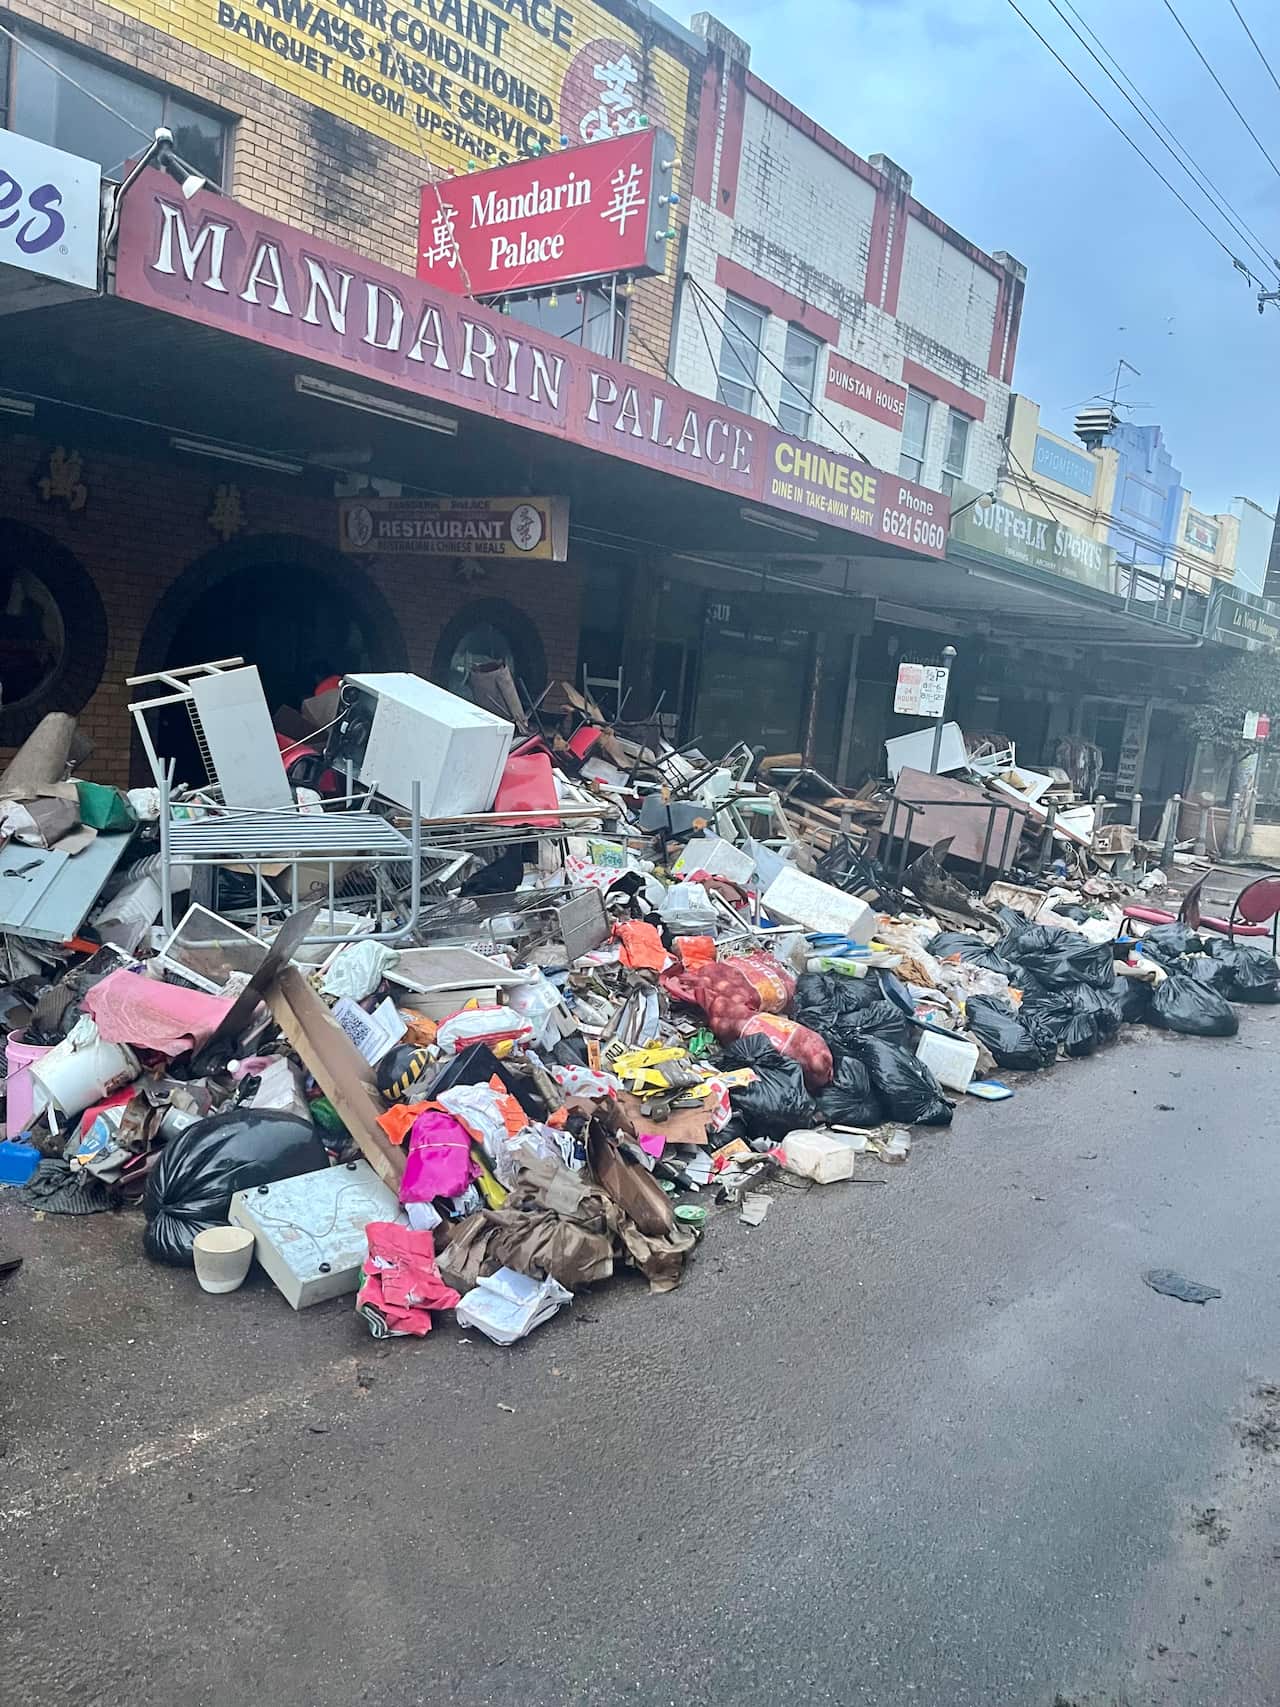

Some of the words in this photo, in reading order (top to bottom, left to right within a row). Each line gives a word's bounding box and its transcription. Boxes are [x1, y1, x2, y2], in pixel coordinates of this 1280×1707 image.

[217, 1, 333, 79] BANQUET
[342, 64, 405, 117] ROOM
[415, 104, 510, 166] UPSTAIRS
[391, 10, 553, 125] CONDITIONED
[377, 41, 452, 107] TABLE
[458, 89, 551, 158] SERVICE
[470, 172, 591, 229] Mandarin
[600, 164, 645, 236] 華
[423, 203, 460, 269] 萬
[488, 232, 565, 271] Palace
[151, 195, 567, 410] MANDARIN
[584, 369, 753, 474] PALACE
[829, 368, 873, 401] DUNSTAN
[875, 390, 905, 417] HOUSE
[775, 442, 877, 505] CHINESE
[772, 478, 793, 500] DINE
[793, 487, 803, 503] IN
[850, 504, 874, 527] PARTY
[882, 507, 912, 540] 6621
[914, 519, 945, 550] 5060
[898, 488, 934, 516] Phone
[378, 520, 504, 539] RESTAURANT
[475, 542, 505, 554] MEALS
[1054, 524, 1102, 571] SPORTS
